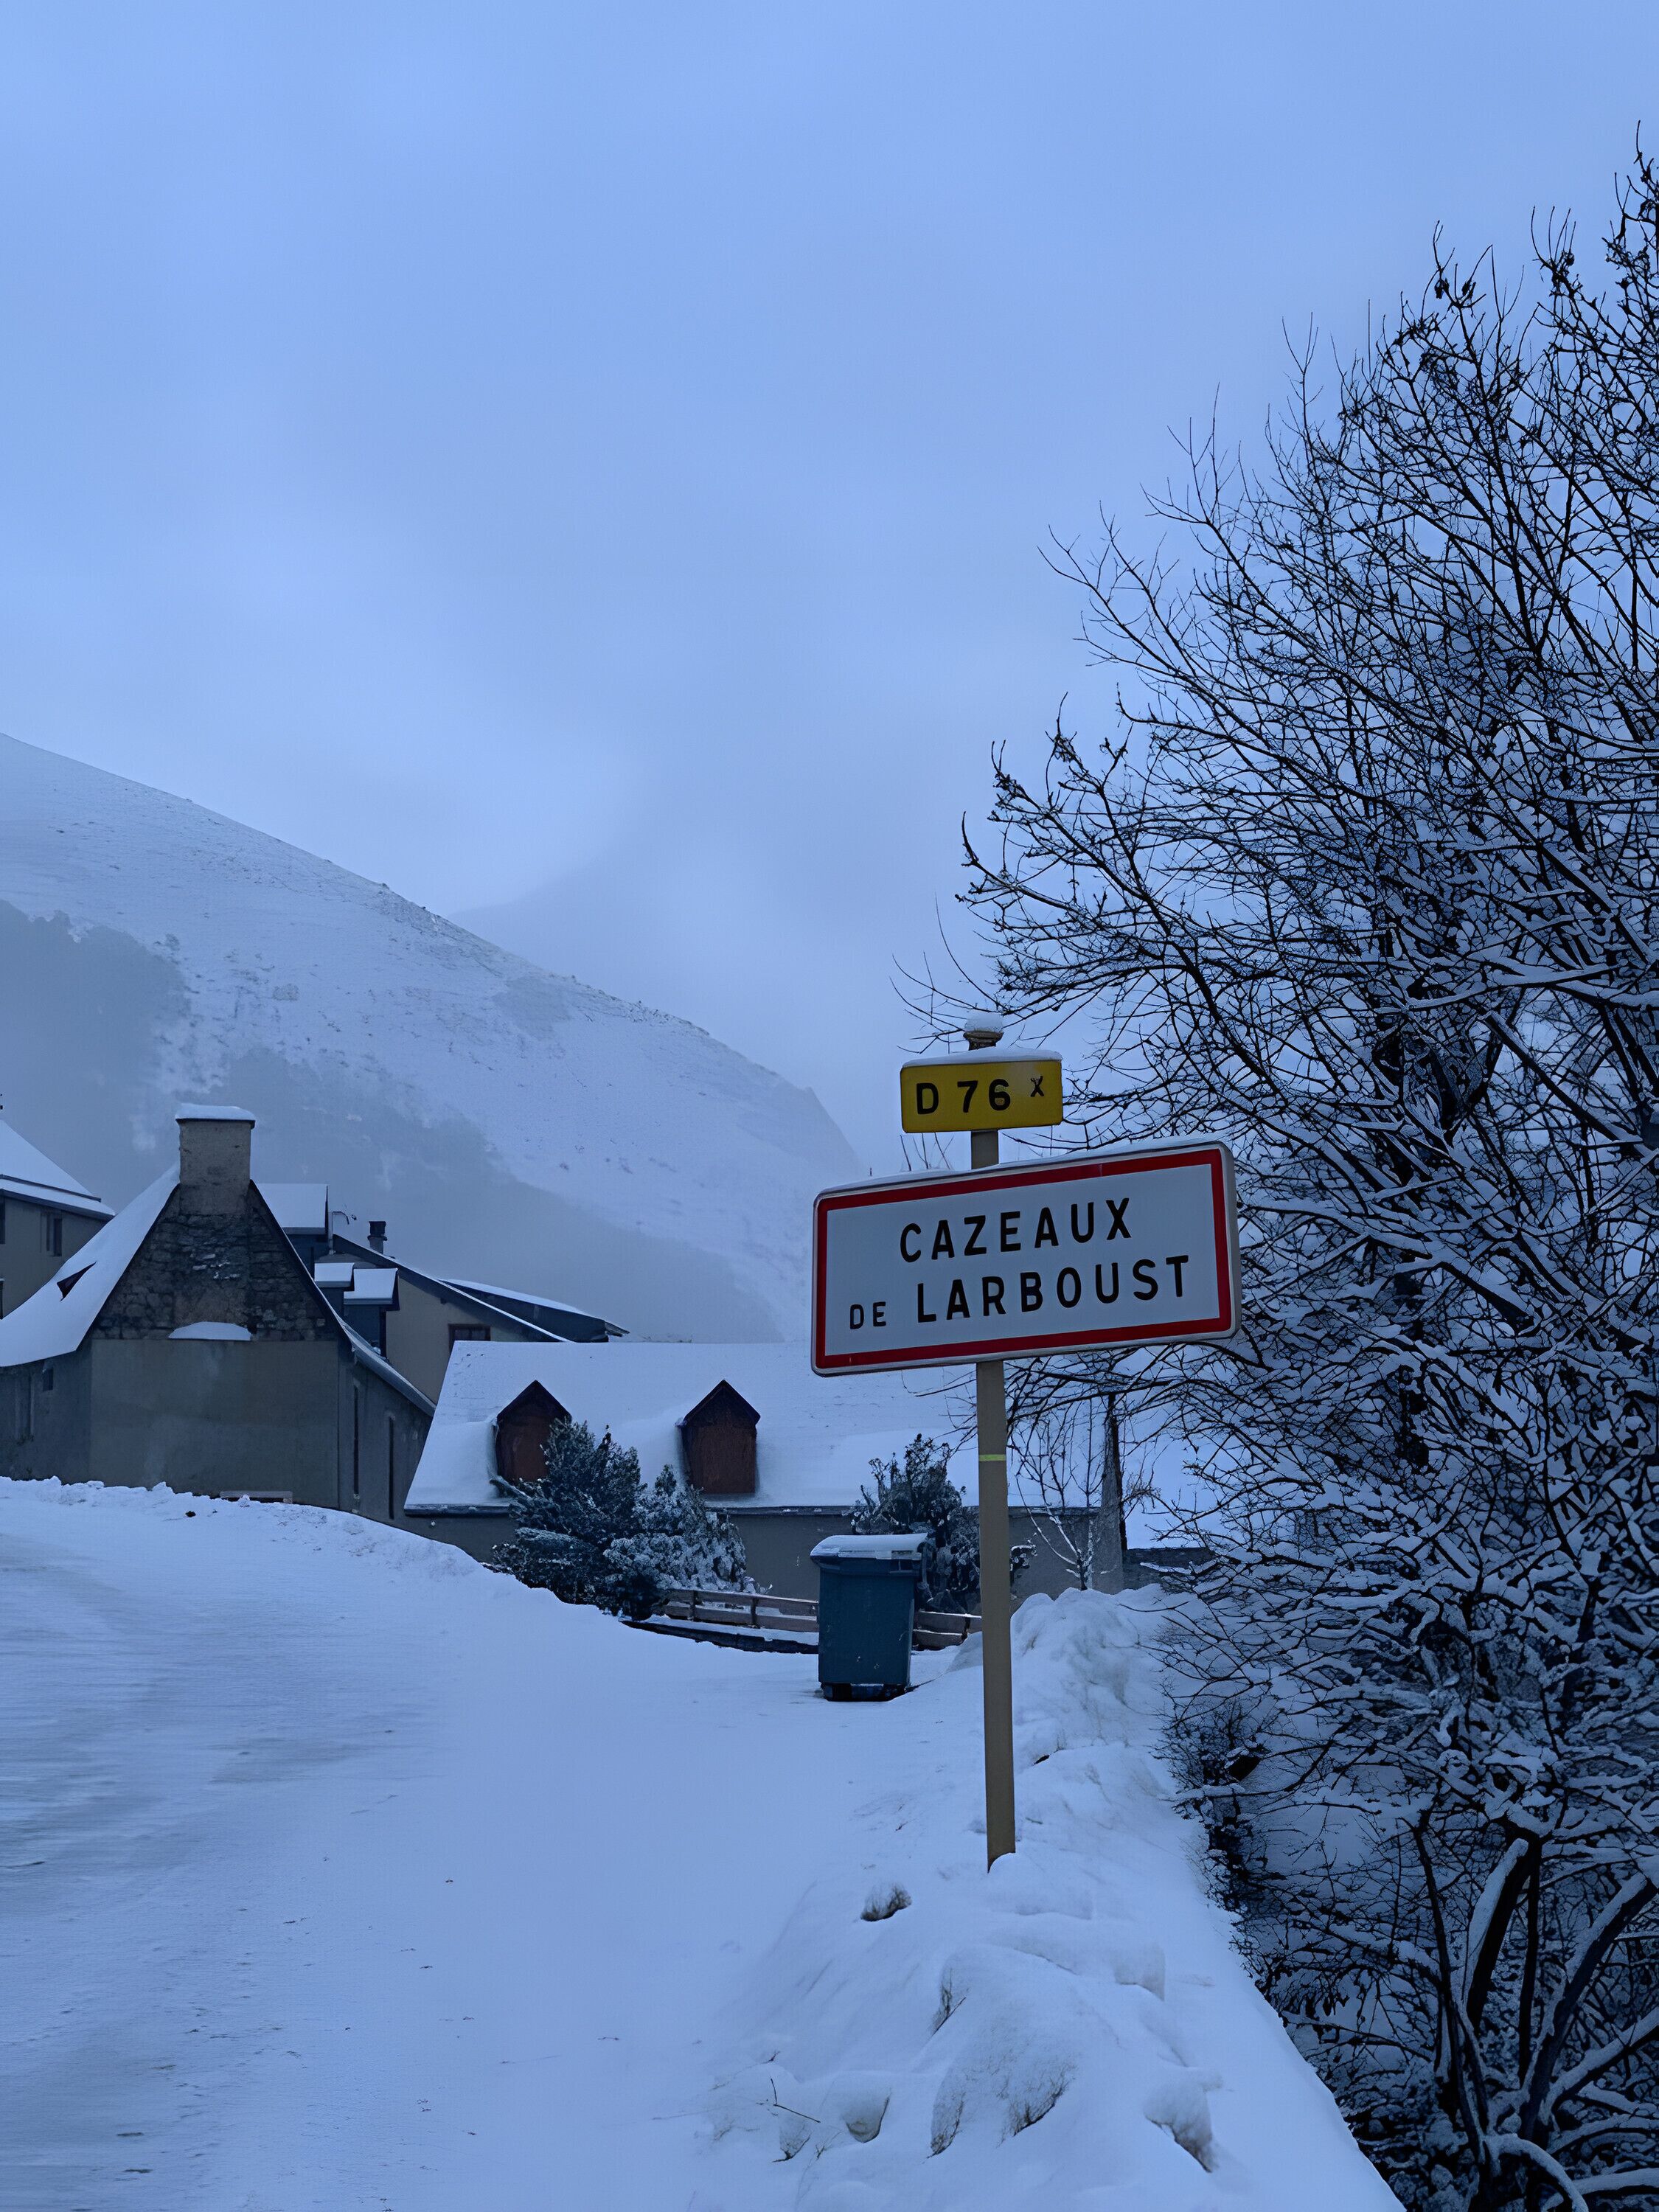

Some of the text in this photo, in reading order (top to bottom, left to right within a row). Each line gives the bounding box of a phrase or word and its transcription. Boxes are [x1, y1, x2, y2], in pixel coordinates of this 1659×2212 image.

[916, 1082, 939, 1115] D
[957, 1078, 1011, 1113] 76
[900, 1197, 1132, 1263] CAZEAUX
[849, 1255, 1189, 1330] DE LARBOUST
